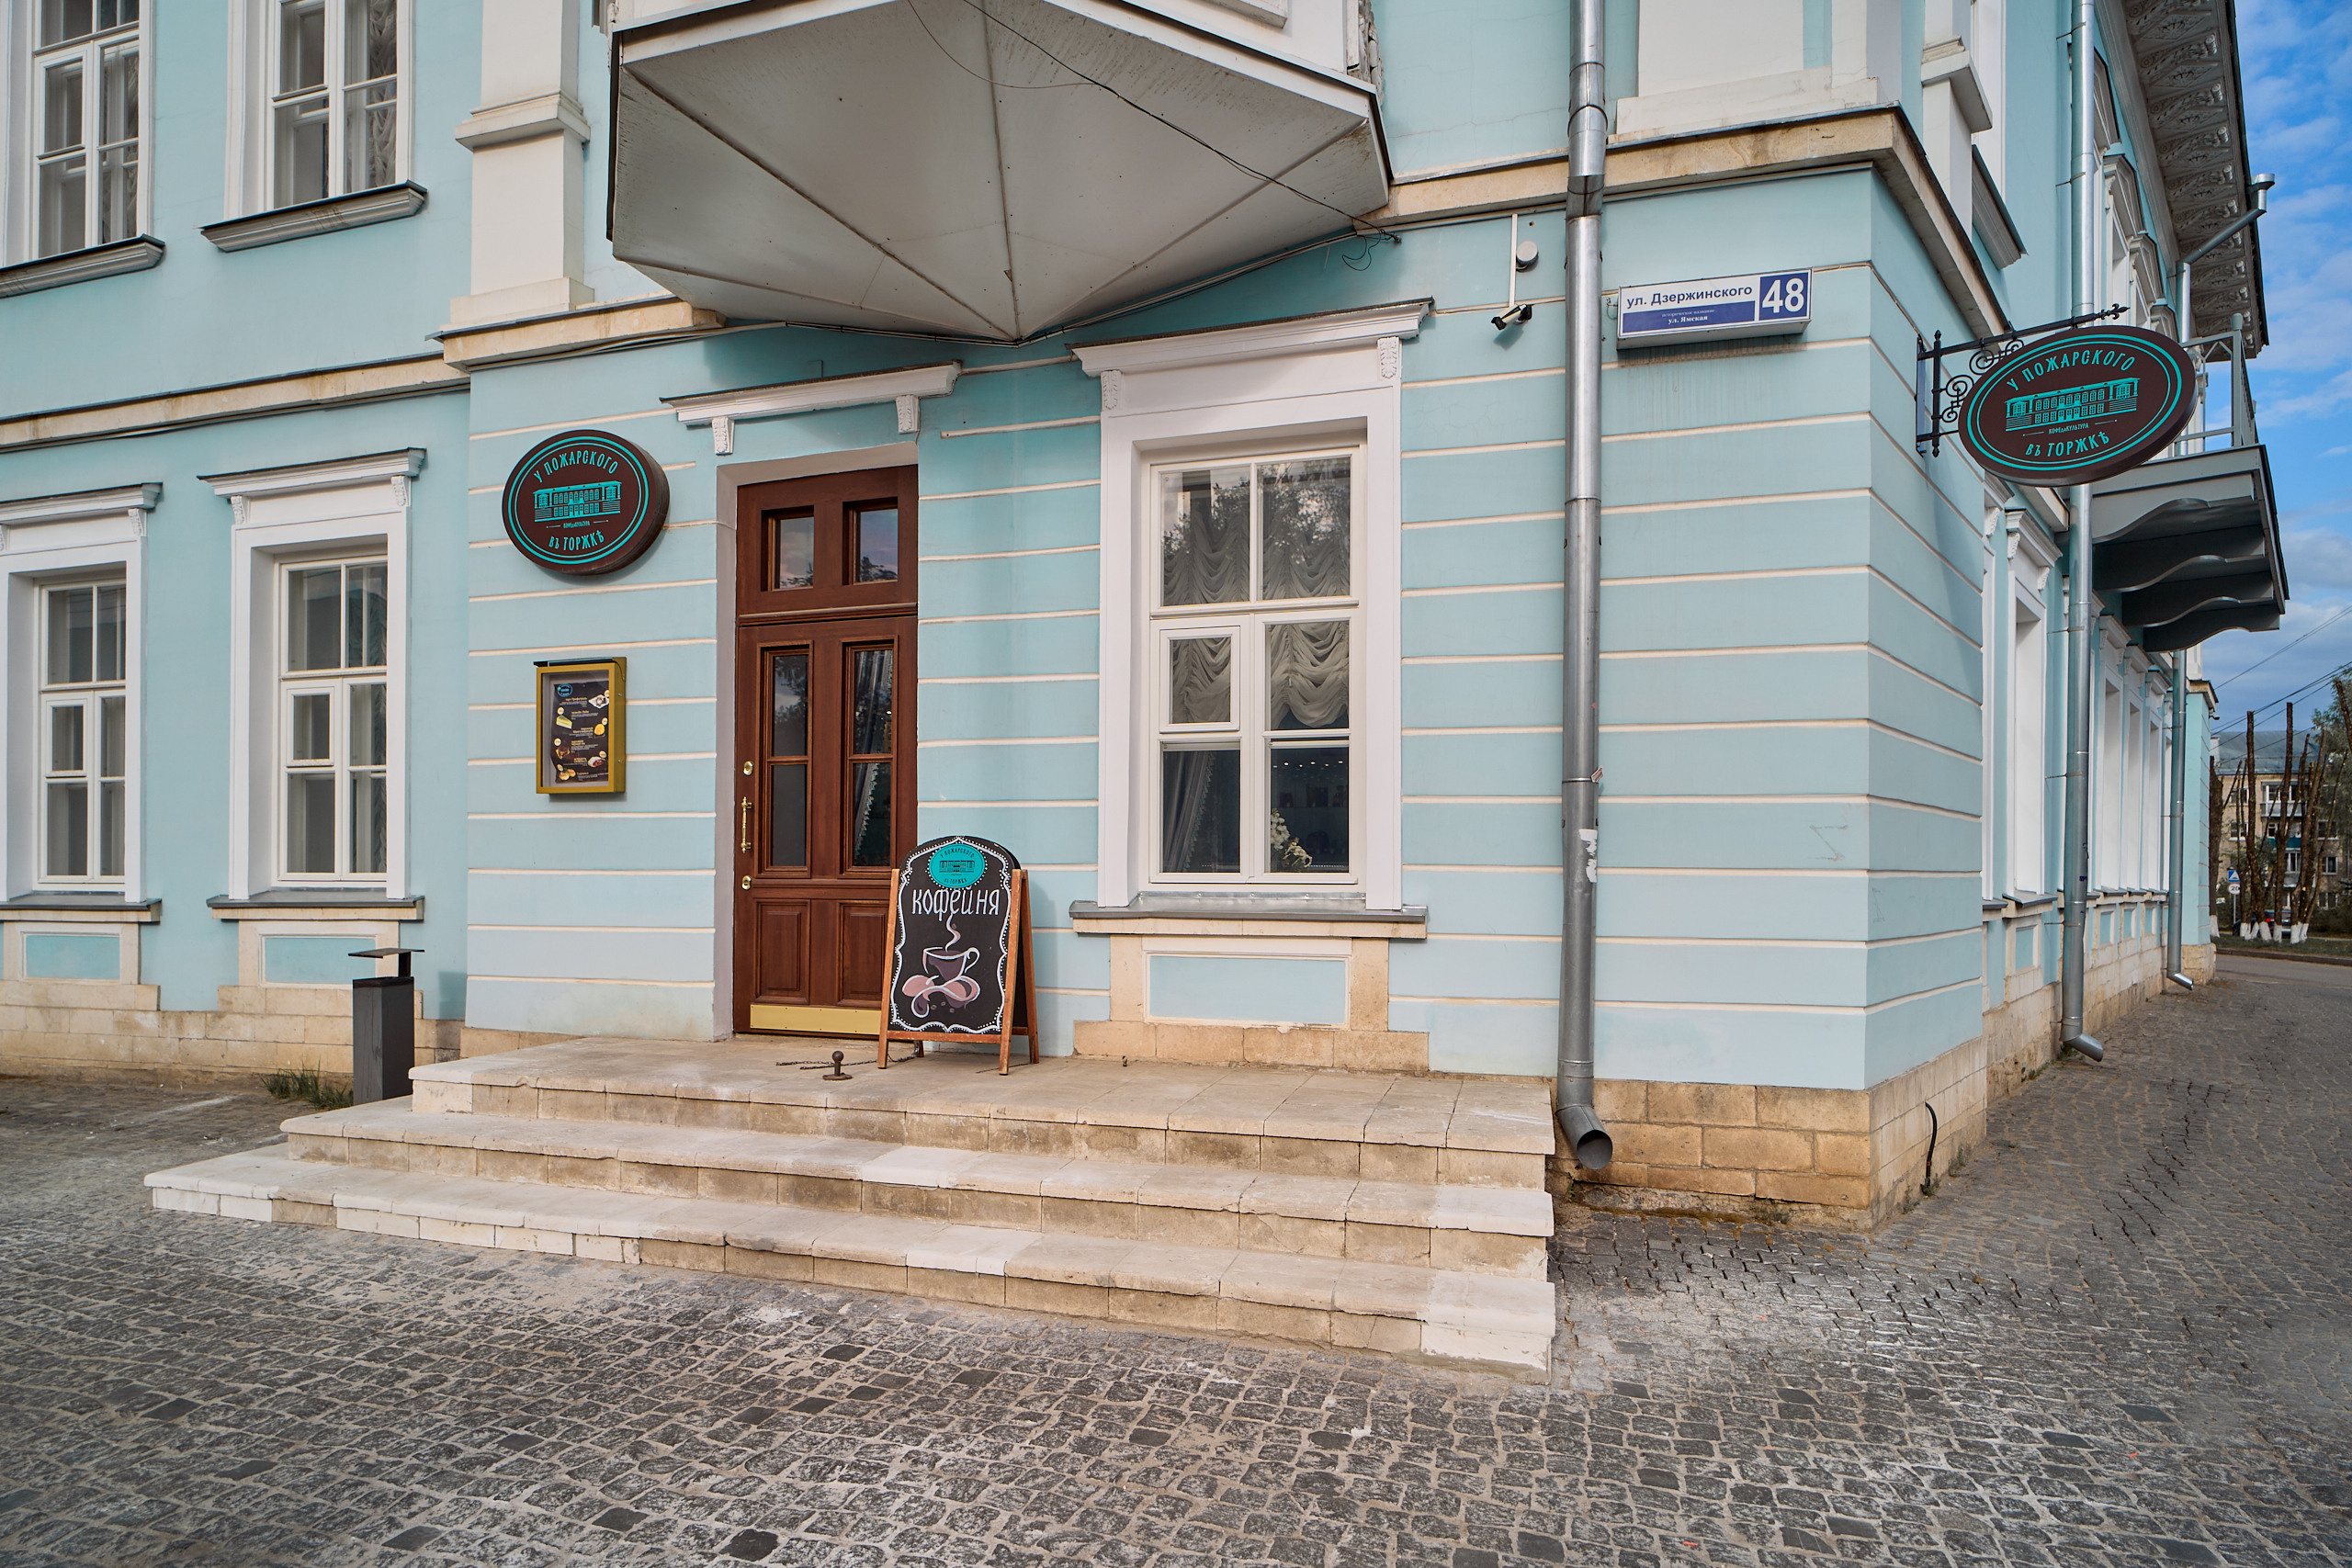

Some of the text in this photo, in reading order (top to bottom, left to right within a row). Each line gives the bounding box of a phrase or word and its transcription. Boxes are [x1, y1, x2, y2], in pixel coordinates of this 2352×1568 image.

[1627, 286, 1753, 310] ул. Дзержинского
[1761, 277, 1804, 313] 48
[1680, 315, 1708, 323] Ямская
[2007, 349, 2135, 391] У ПОЖАРСКОГО
[533, 450, 618, 483] У ПОЖАРСКОГО
[944, 847, 975, 859] ПОЖАРСКОГО
[911, 886, 1000, 921] кофейня
